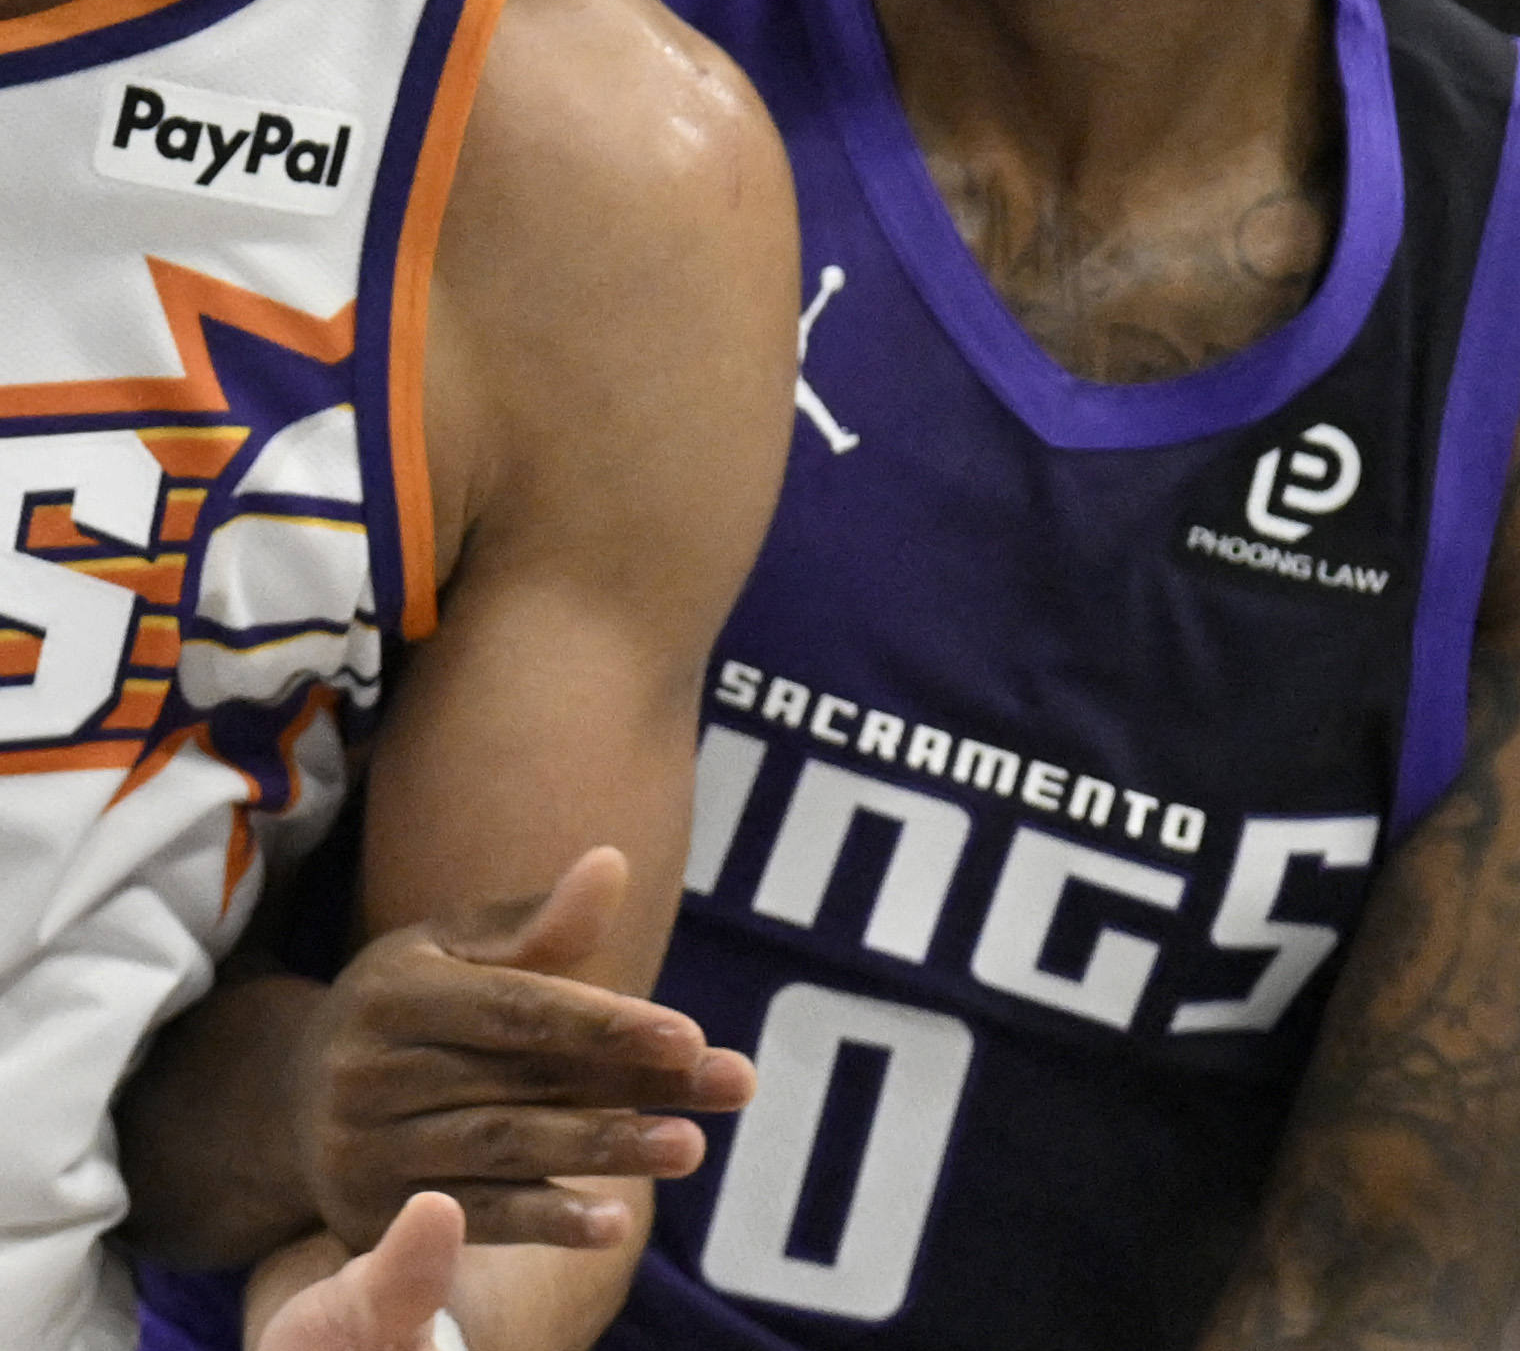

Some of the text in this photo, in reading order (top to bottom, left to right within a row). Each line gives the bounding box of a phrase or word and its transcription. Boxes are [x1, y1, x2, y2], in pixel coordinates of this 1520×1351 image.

[111, 84, 351, 189] PayPal
[1187, 523, 1390, 595] PHOONG LAW
[714, 660, 1206, 852] SACRAMENTO
[682, 722, 1380, 1035] INGS
[700, 981, 975, 1323] 0
